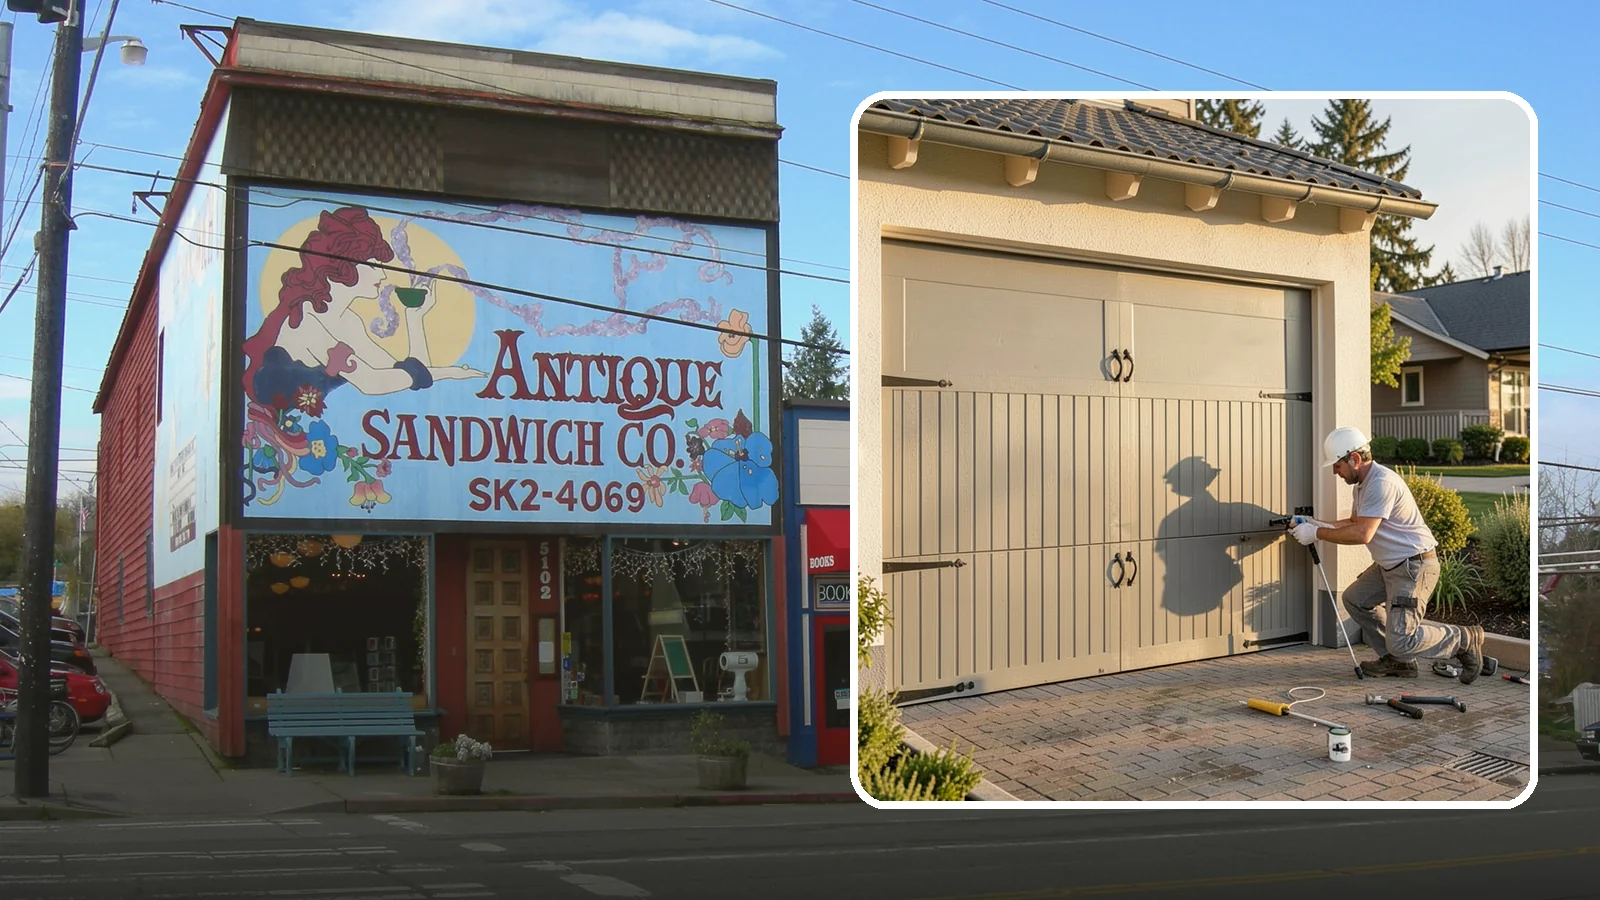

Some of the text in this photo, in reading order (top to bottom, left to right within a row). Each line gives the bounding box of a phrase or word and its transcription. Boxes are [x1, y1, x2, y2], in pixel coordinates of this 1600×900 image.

[475, 329, 723, 420] ANTIQUE
[362, 408, 685, 469] SANDWICH CO.
[468, 477, 646, 513] SK2-4069
[540, 541, 551, 600] 5102
[809, 555, 835, 568] BOOKS
